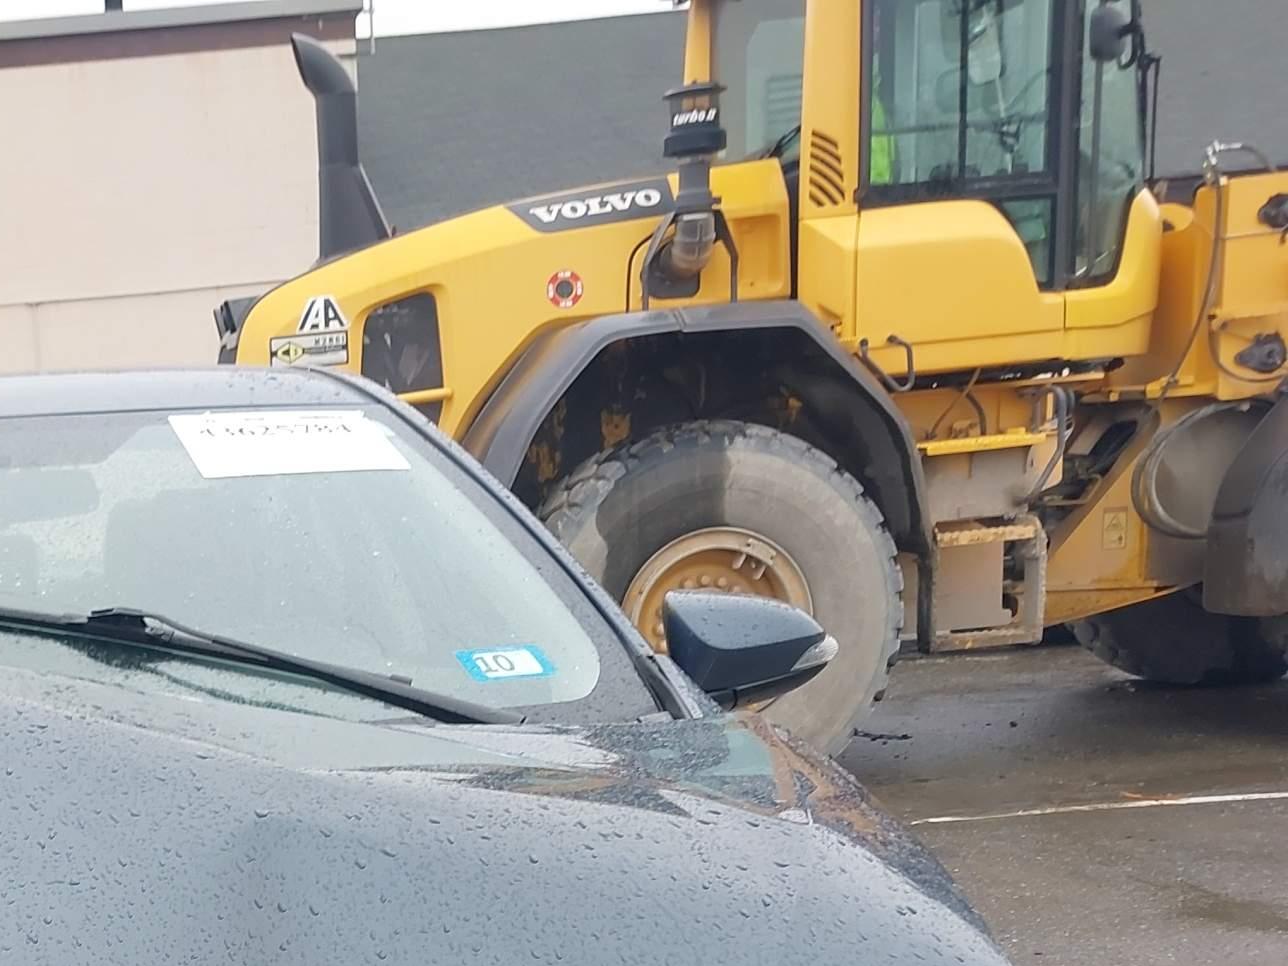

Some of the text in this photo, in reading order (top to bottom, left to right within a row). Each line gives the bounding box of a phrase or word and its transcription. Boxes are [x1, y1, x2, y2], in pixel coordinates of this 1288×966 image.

[673, 109, 706, 127] turbo
[529, 188, 661, 223] VOLVO
[474, 654, 516, 673] 10
